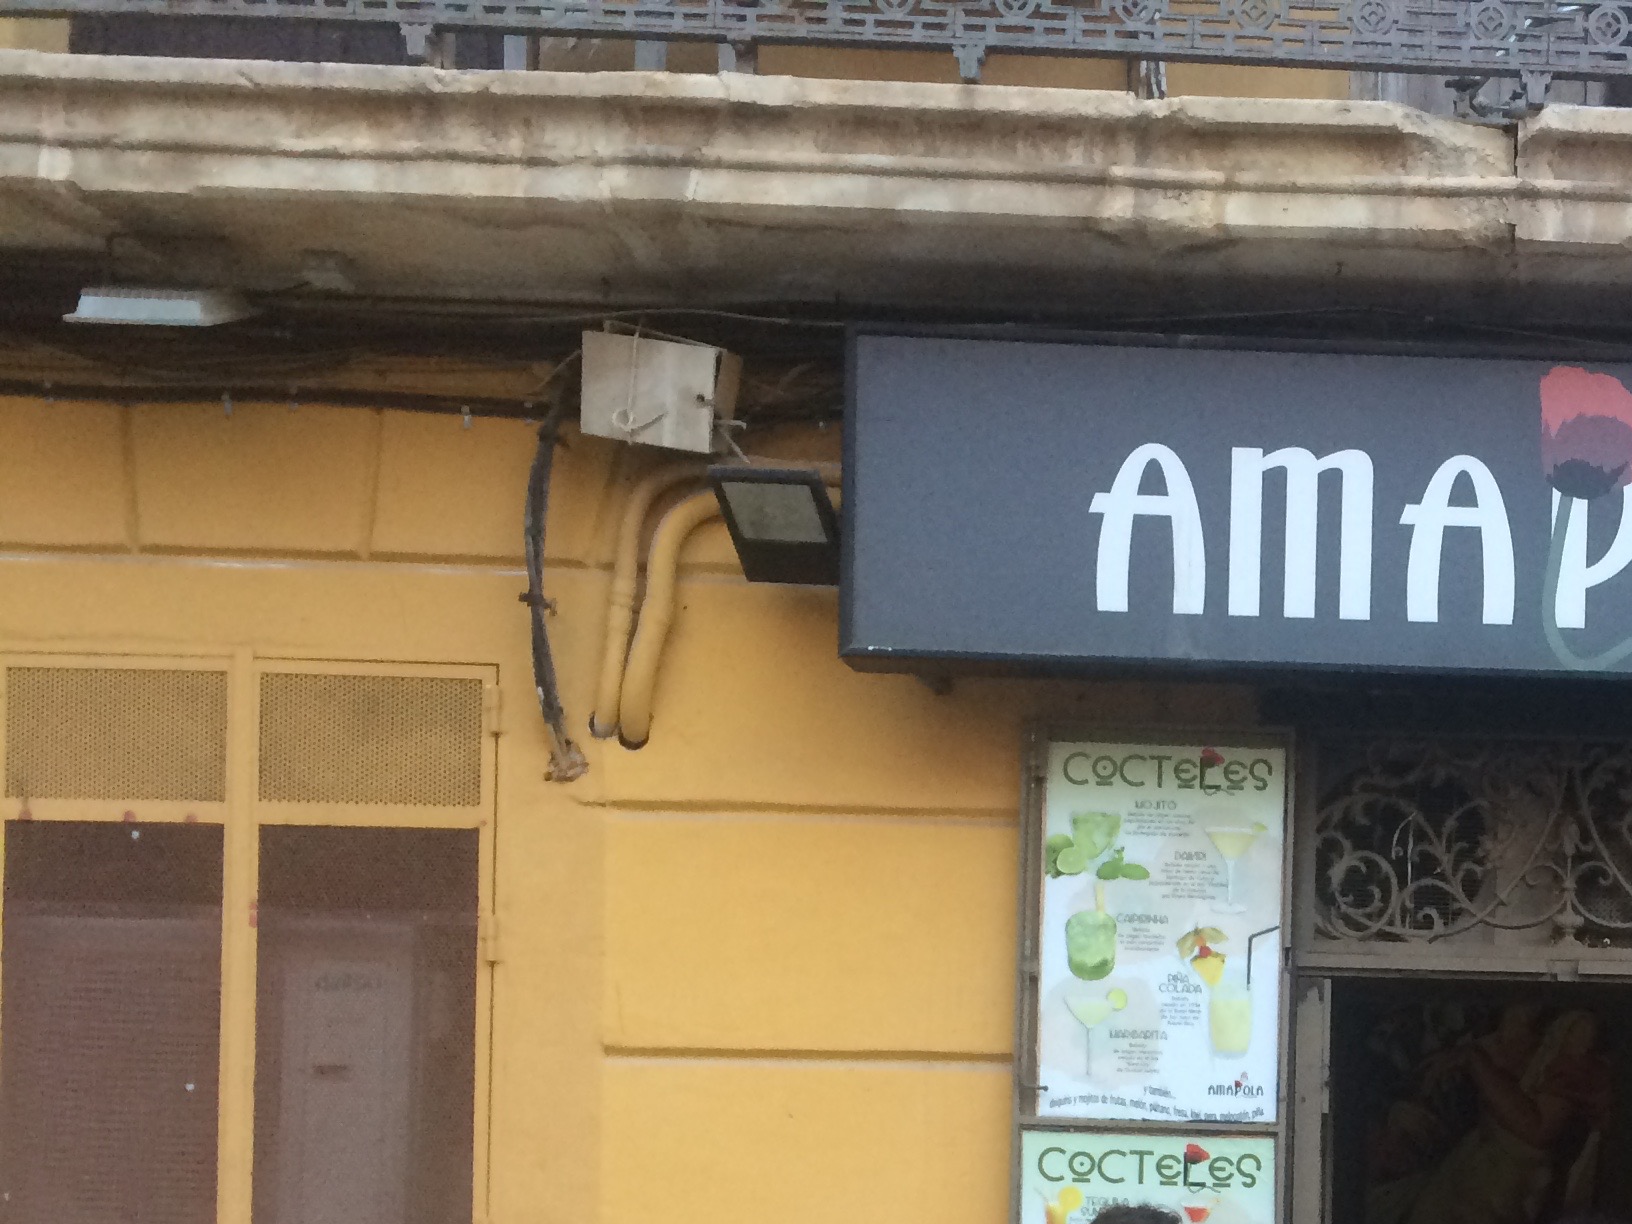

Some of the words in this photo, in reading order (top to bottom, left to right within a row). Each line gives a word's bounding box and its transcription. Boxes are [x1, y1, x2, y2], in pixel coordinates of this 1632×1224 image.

[1062, 751, 1273, 792] COCTELES
[1159, 983, 1202, 994] COLADA
[1208, 1083, 1264, 1098] AMAPOLA
[1037, 1146, 1262, 1189] COCTELES
